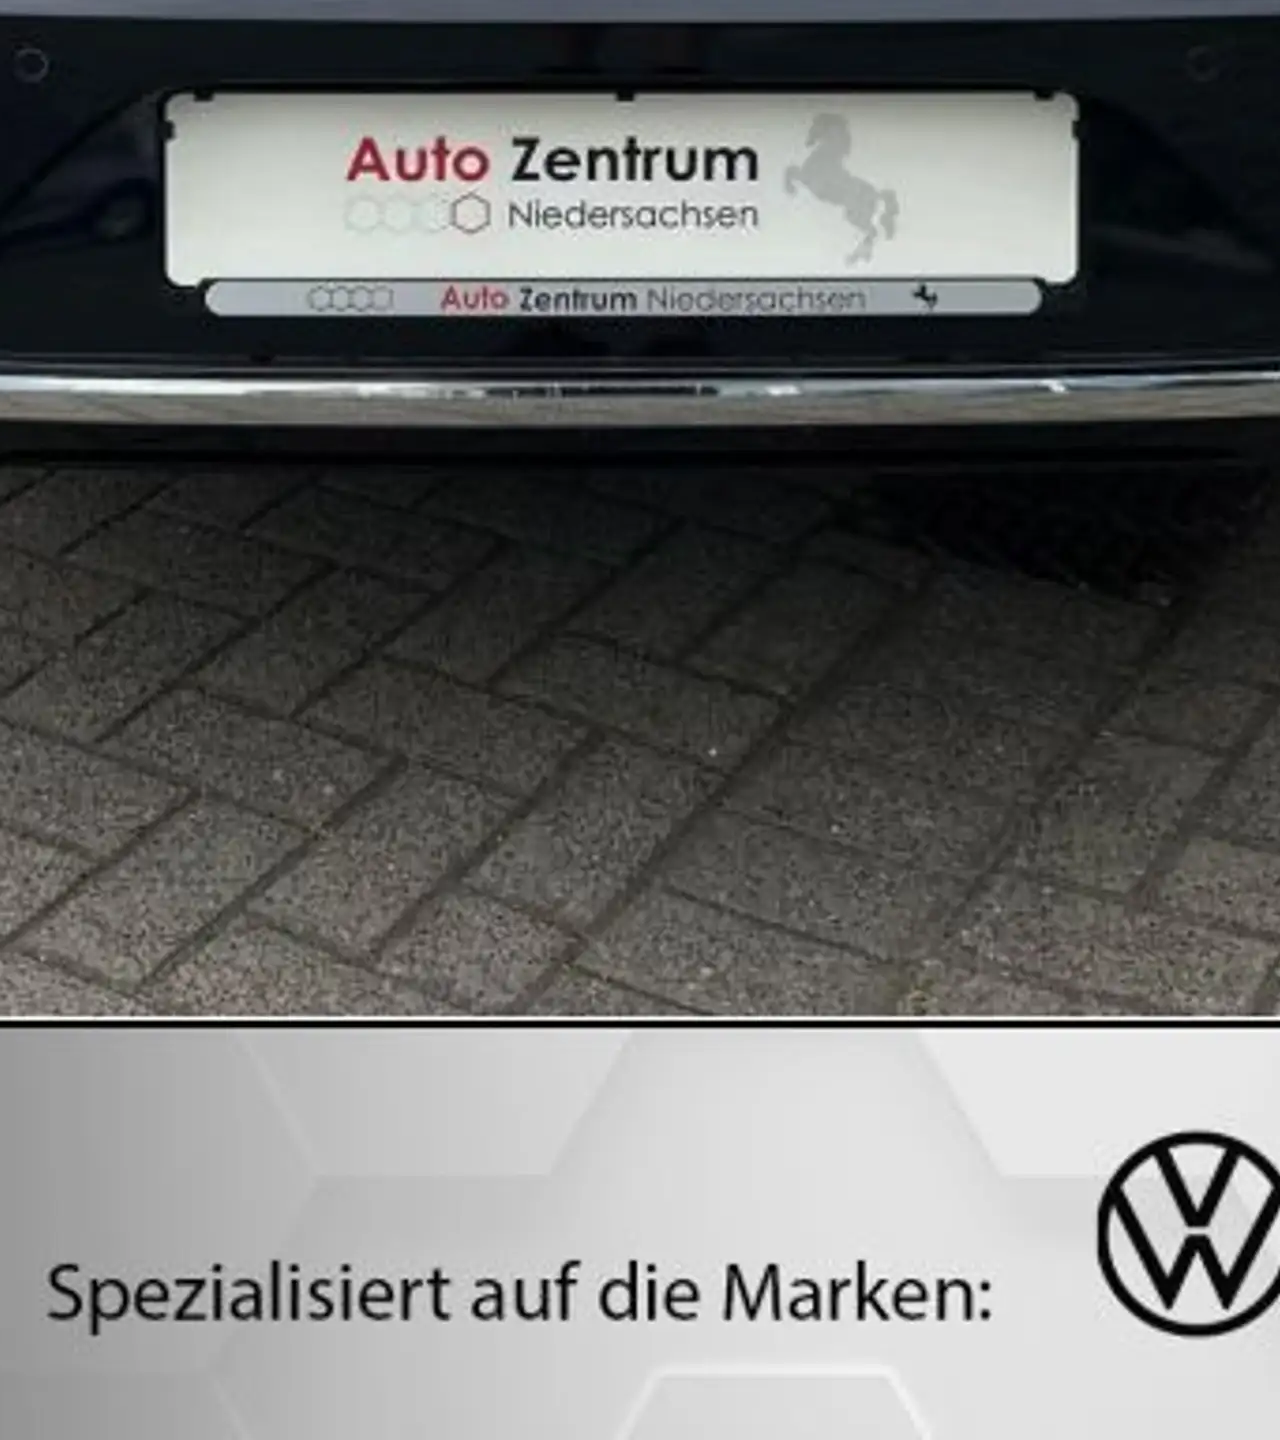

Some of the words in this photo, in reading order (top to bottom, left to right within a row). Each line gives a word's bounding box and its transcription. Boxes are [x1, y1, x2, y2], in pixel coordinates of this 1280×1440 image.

[345, 135, 491, 185] Auto
[511, 135, 760, 184] Zentrum
[508, 198, 760, 232] Niedersachsen
[440, 286, 510, 313] Auto
[518, 287, 638, 313] Zentrum
[646, 285, 867, 313] Niedersachsen
